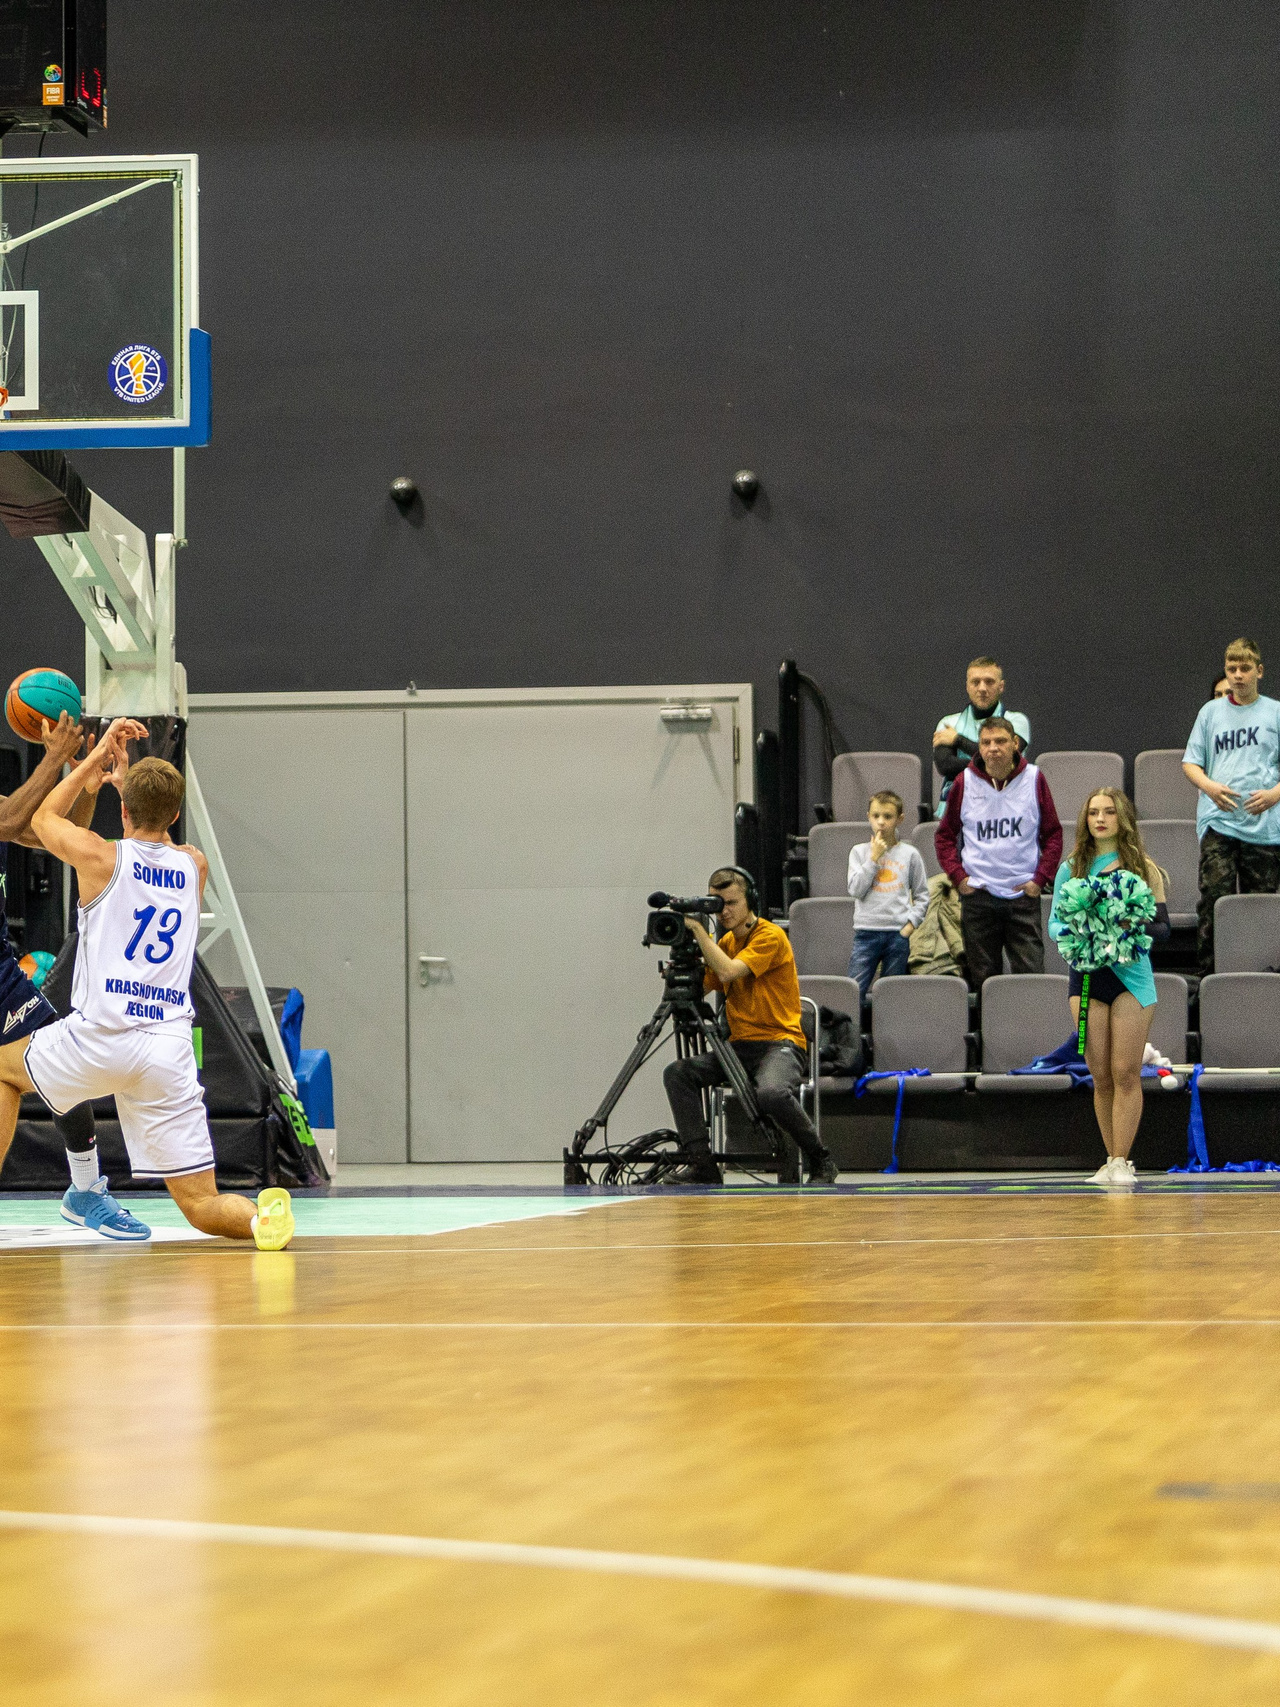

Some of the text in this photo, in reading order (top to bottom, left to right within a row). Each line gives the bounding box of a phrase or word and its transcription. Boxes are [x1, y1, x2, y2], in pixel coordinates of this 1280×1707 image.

[111, 345, 162, 366] ЕДИНАЯ ЛИГА ВТБ
[113, 381, 165, 404] VTB UNITED LEAGUE
[133, 861, 186, 890] SONKO
[123, 904, 182, 964] 13
[105, 978, 186, 1006] KRASNOYARSK
